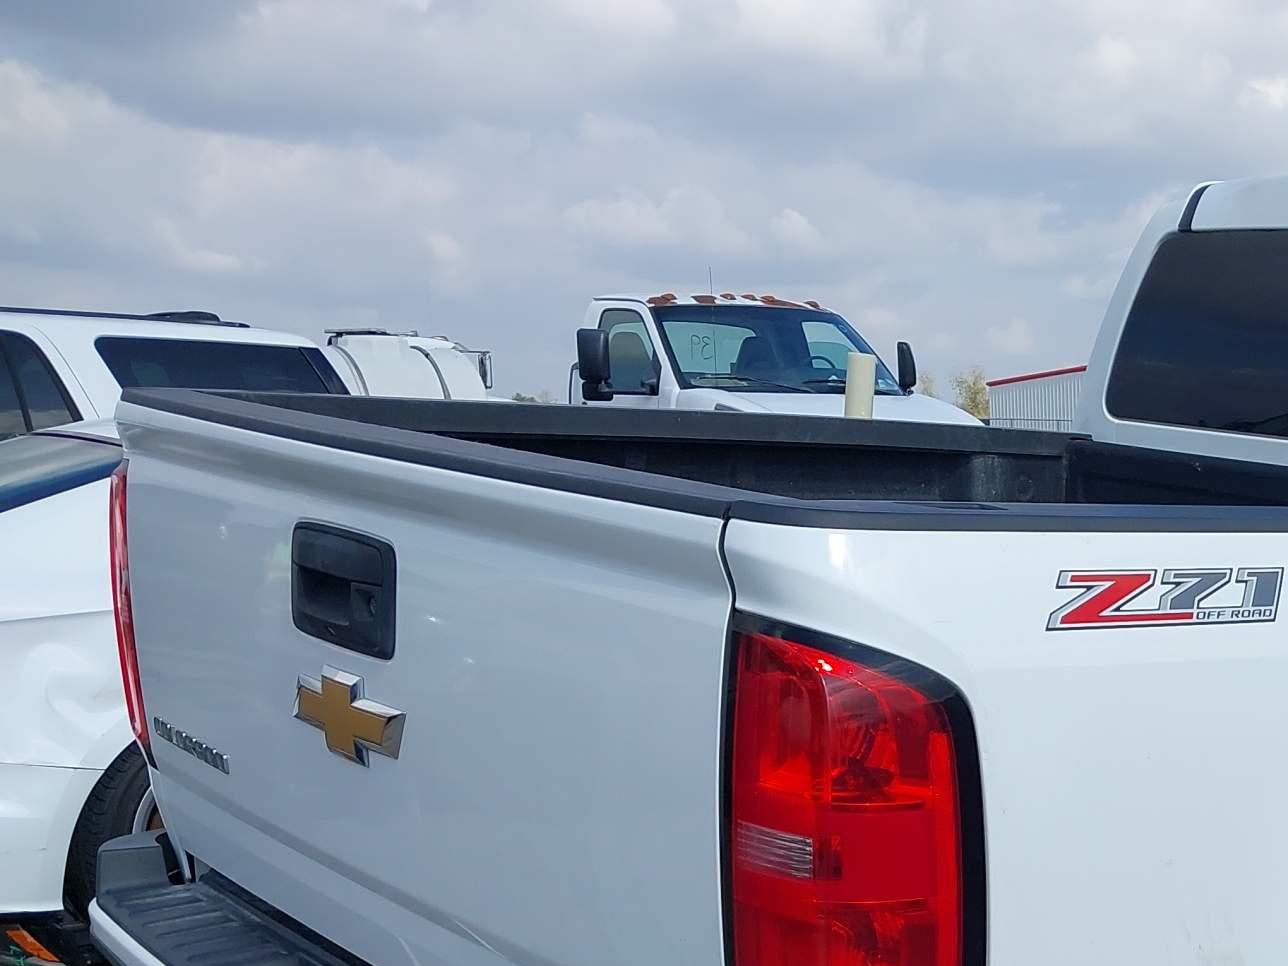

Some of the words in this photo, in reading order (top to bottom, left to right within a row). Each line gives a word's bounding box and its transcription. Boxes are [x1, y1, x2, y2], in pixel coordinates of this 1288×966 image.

[1046, 567, 1284, 631] Z71
[1195, 610, 1226, 620] OFF
[1230, 608, 1273, 620] ROAD
